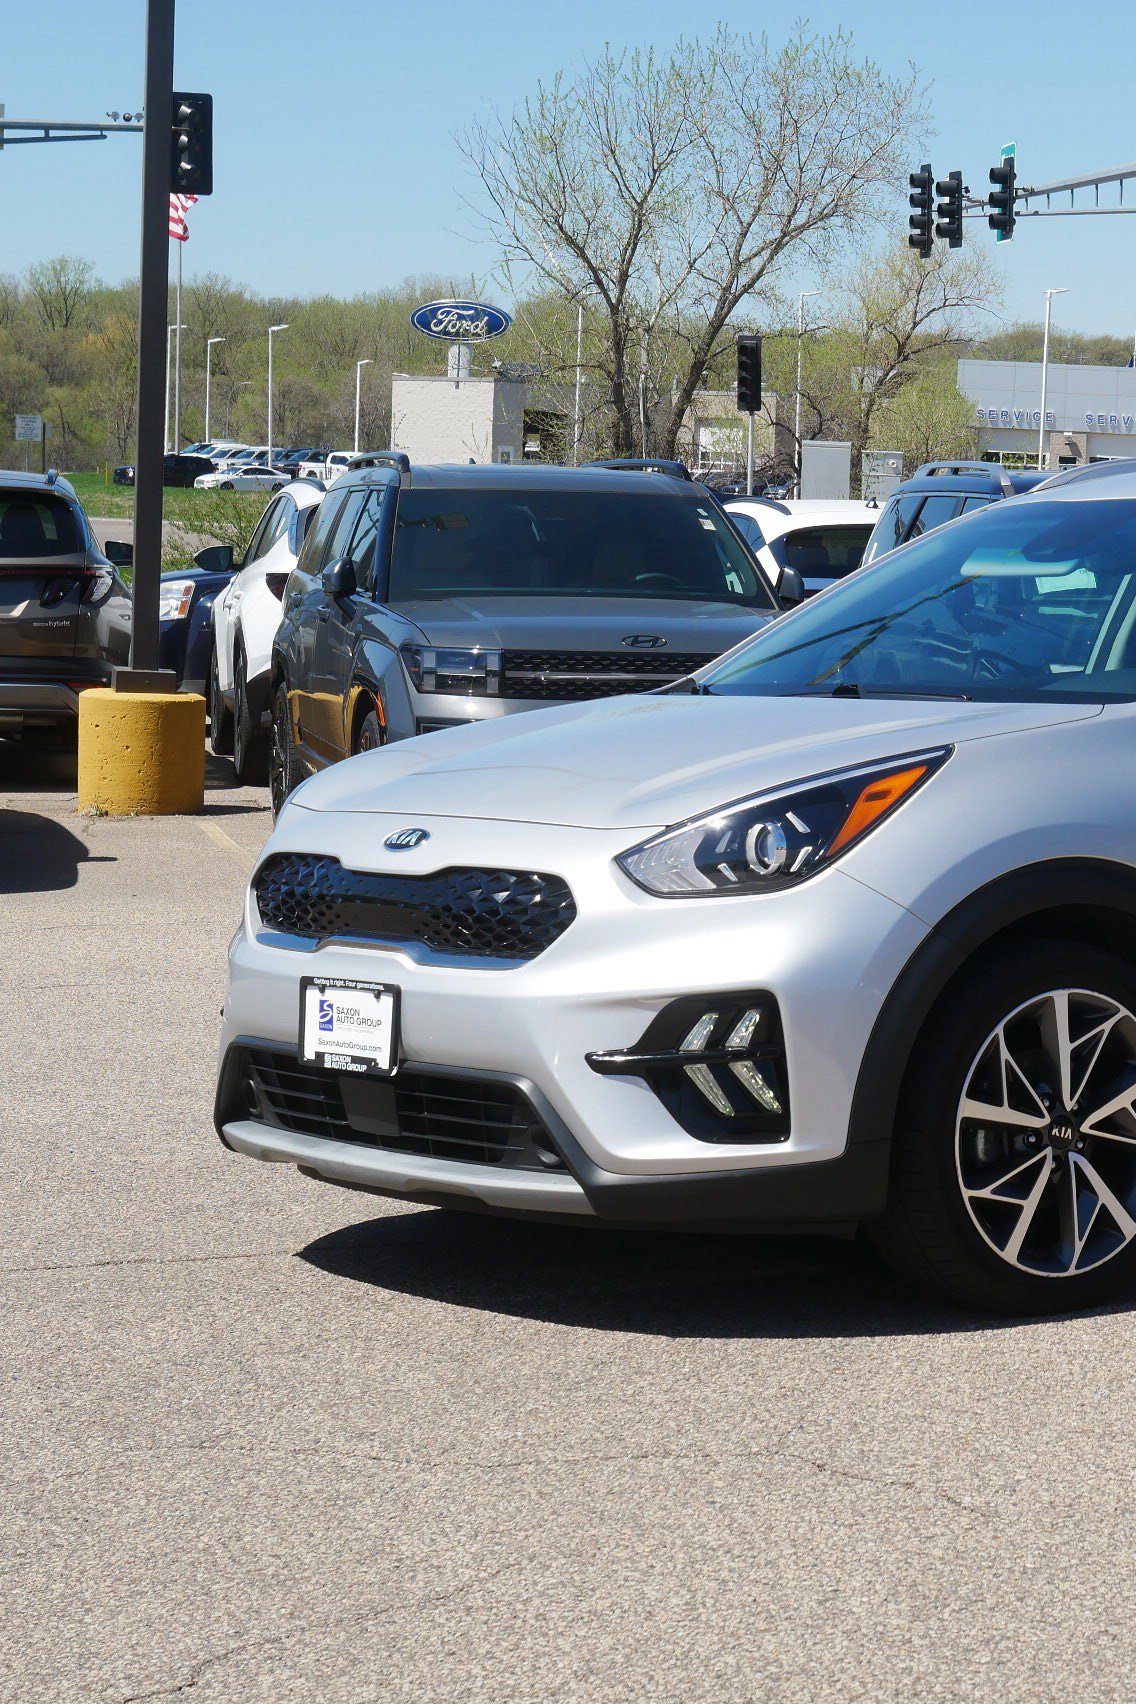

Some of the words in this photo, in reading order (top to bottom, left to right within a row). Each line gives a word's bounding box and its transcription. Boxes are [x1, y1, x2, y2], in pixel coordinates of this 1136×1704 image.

[430, 308, 489, 333] Ford
[976, 409, 1054, 422] SERVICE
[336, 1006, 360, 1017] SAXON
[336, 1014, 355, 1025] AUTO
[356, 1017, 382, 1028] GROUP
[318, 1037, 383, 1052] SaxonAutoGroup.com
[331, 1053, 352, 1063] SAXON
[331, 1061, 347, 1070] AUTO
[346, 1063, 368, 1073] GROUP
[1051, 1125, 1072, 1140] KIA
